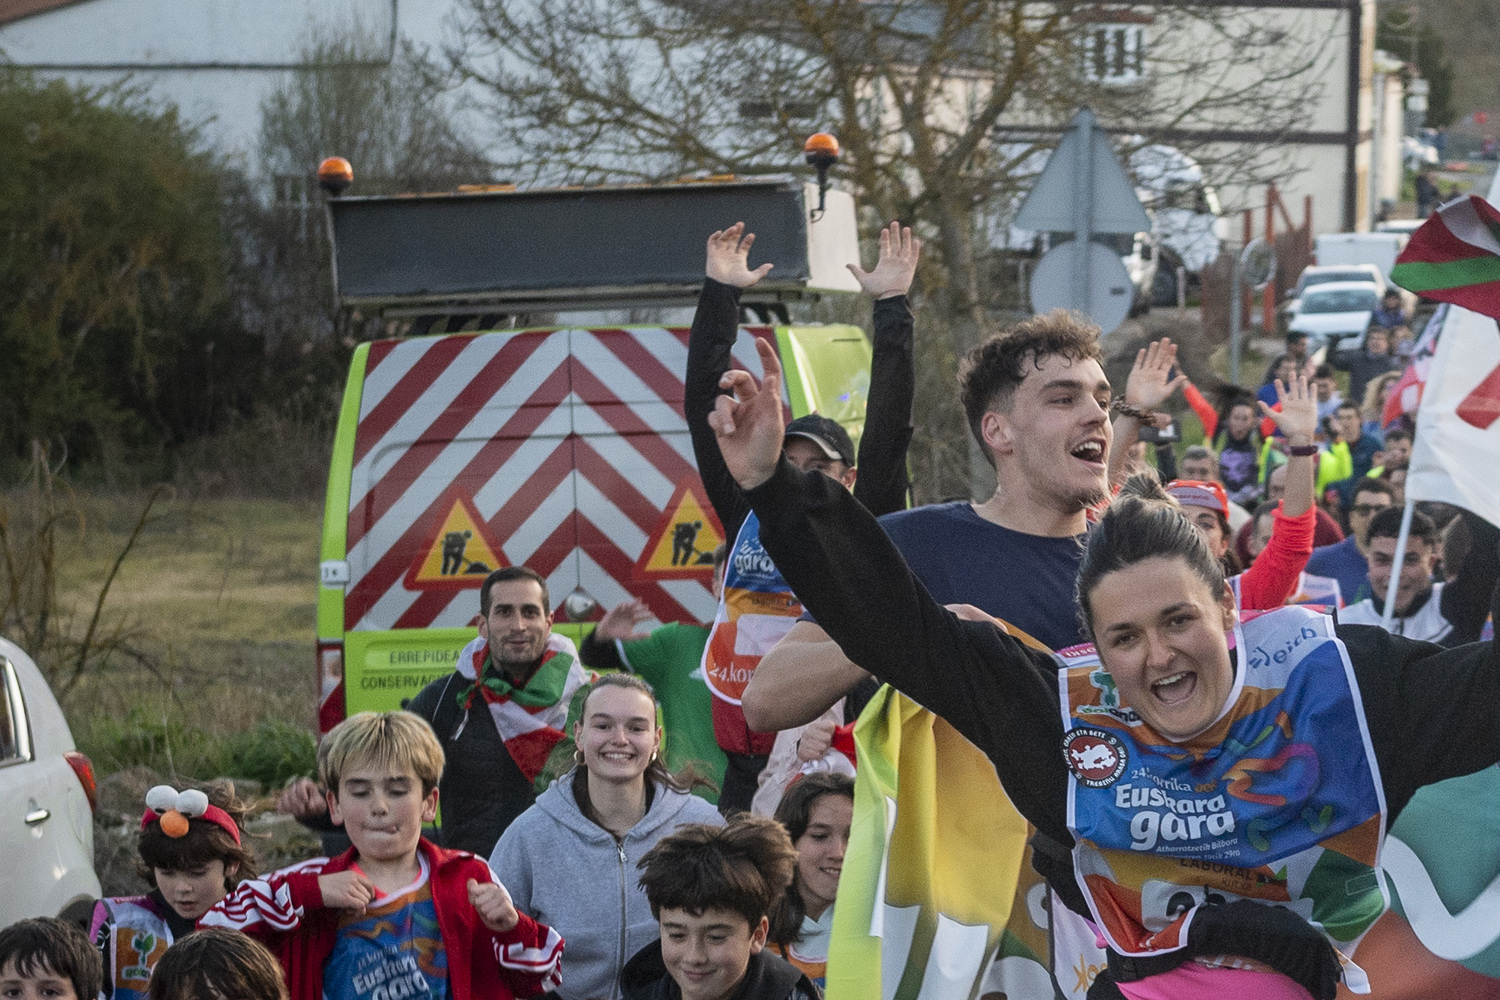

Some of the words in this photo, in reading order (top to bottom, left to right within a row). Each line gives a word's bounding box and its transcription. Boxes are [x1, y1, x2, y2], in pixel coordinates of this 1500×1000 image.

[390, 649, 459, 665] ERREPIDEA
[1115, 783, 1226, 814] Euskara
[1130, 810, 1236, 851] gara
